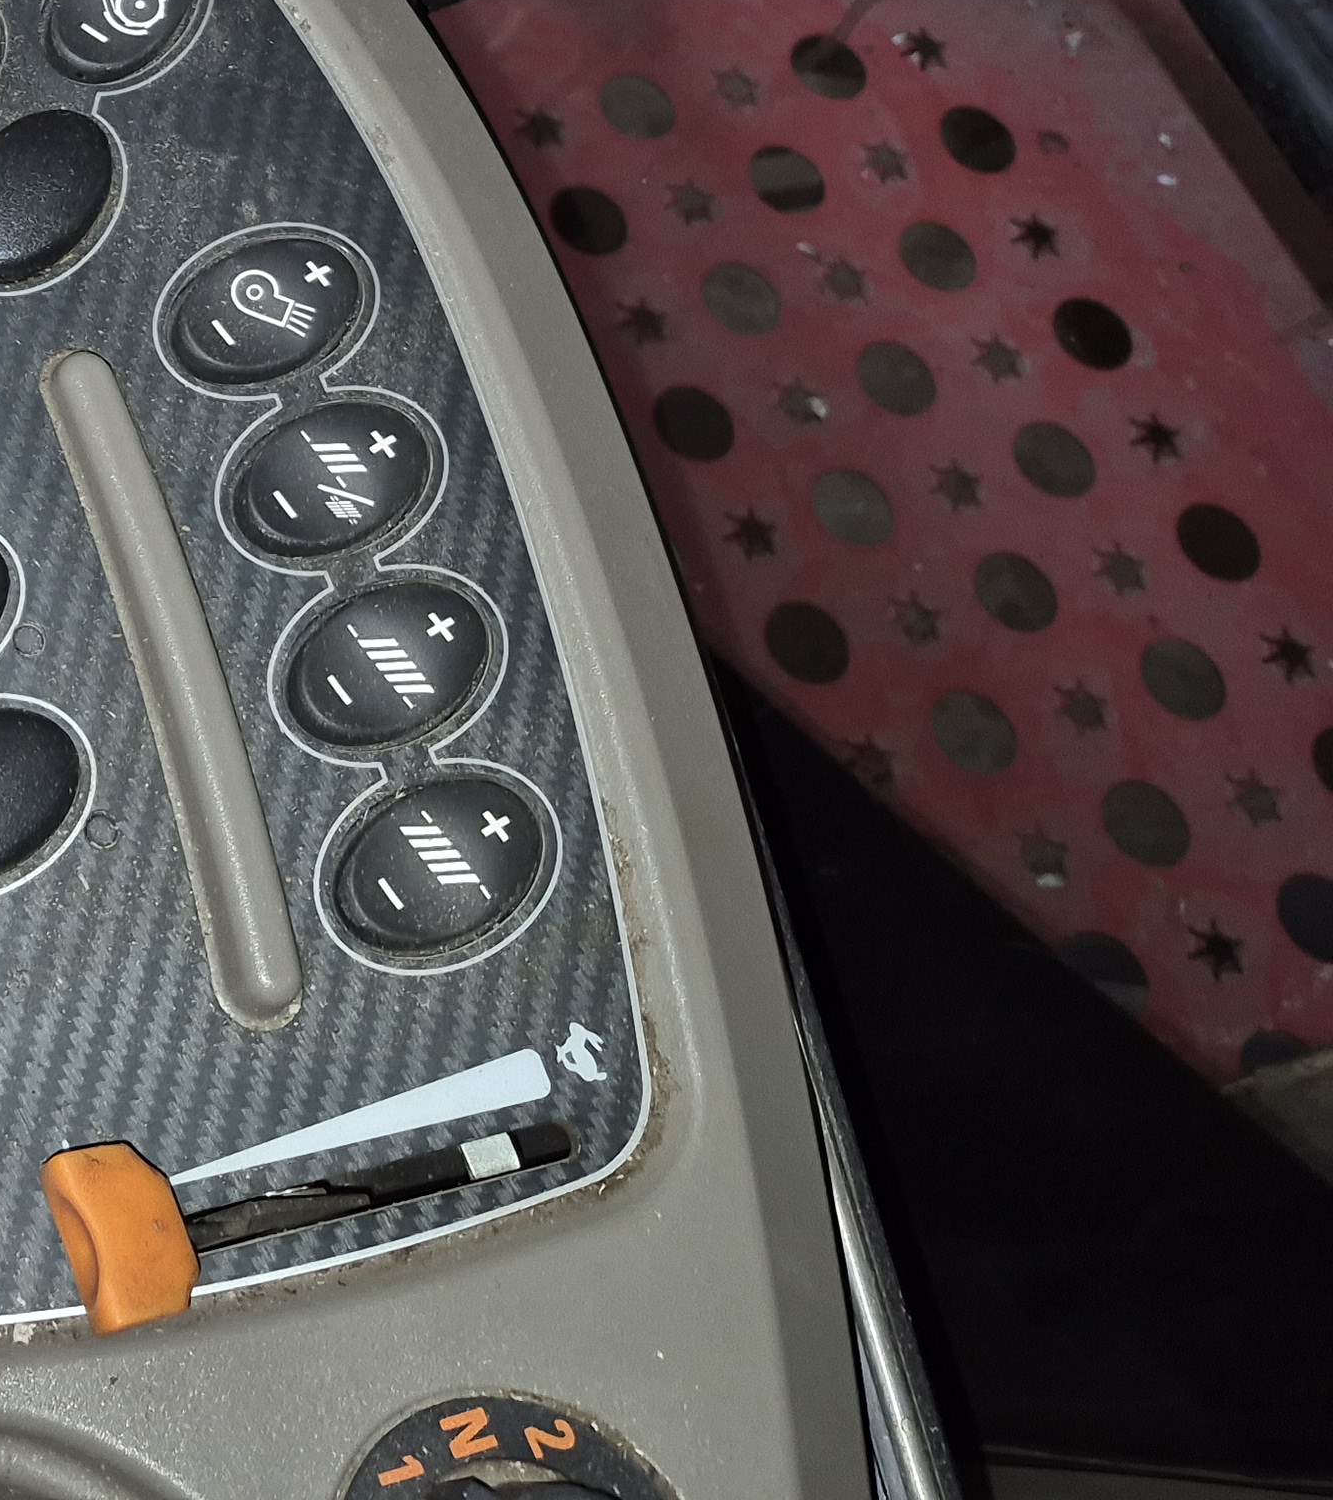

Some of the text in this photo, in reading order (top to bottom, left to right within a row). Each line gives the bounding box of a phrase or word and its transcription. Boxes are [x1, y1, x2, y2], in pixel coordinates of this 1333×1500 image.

[439, 1407, 499, 1459] N
[524, 1419, 576, 1460] 2
[377, 1455, 425, 1487] 1
